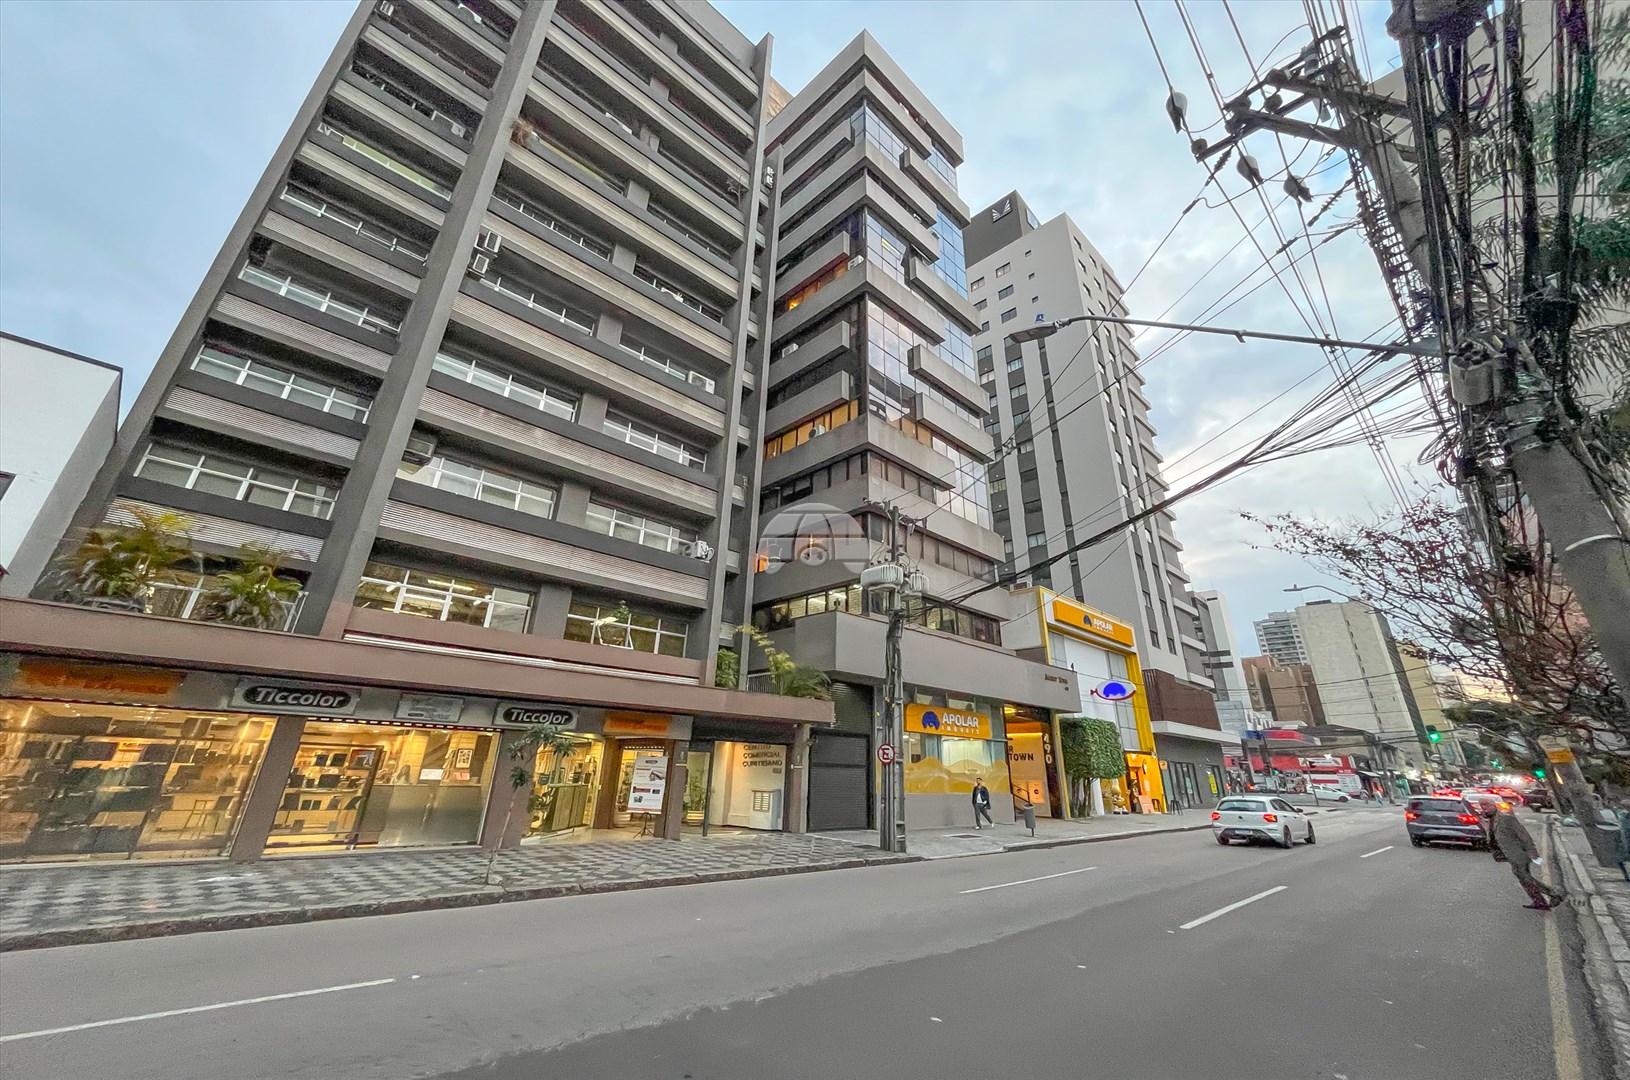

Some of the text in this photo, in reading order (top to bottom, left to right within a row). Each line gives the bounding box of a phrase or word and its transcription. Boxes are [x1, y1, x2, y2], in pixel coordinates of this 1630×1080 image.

[255, 687, 344, 707] Ticcolor
[510, 708, 569, 724] Ticcolor
[942, 712, 979, 728] APOLAR
[1009, 752, 1034, 762] TOWN
